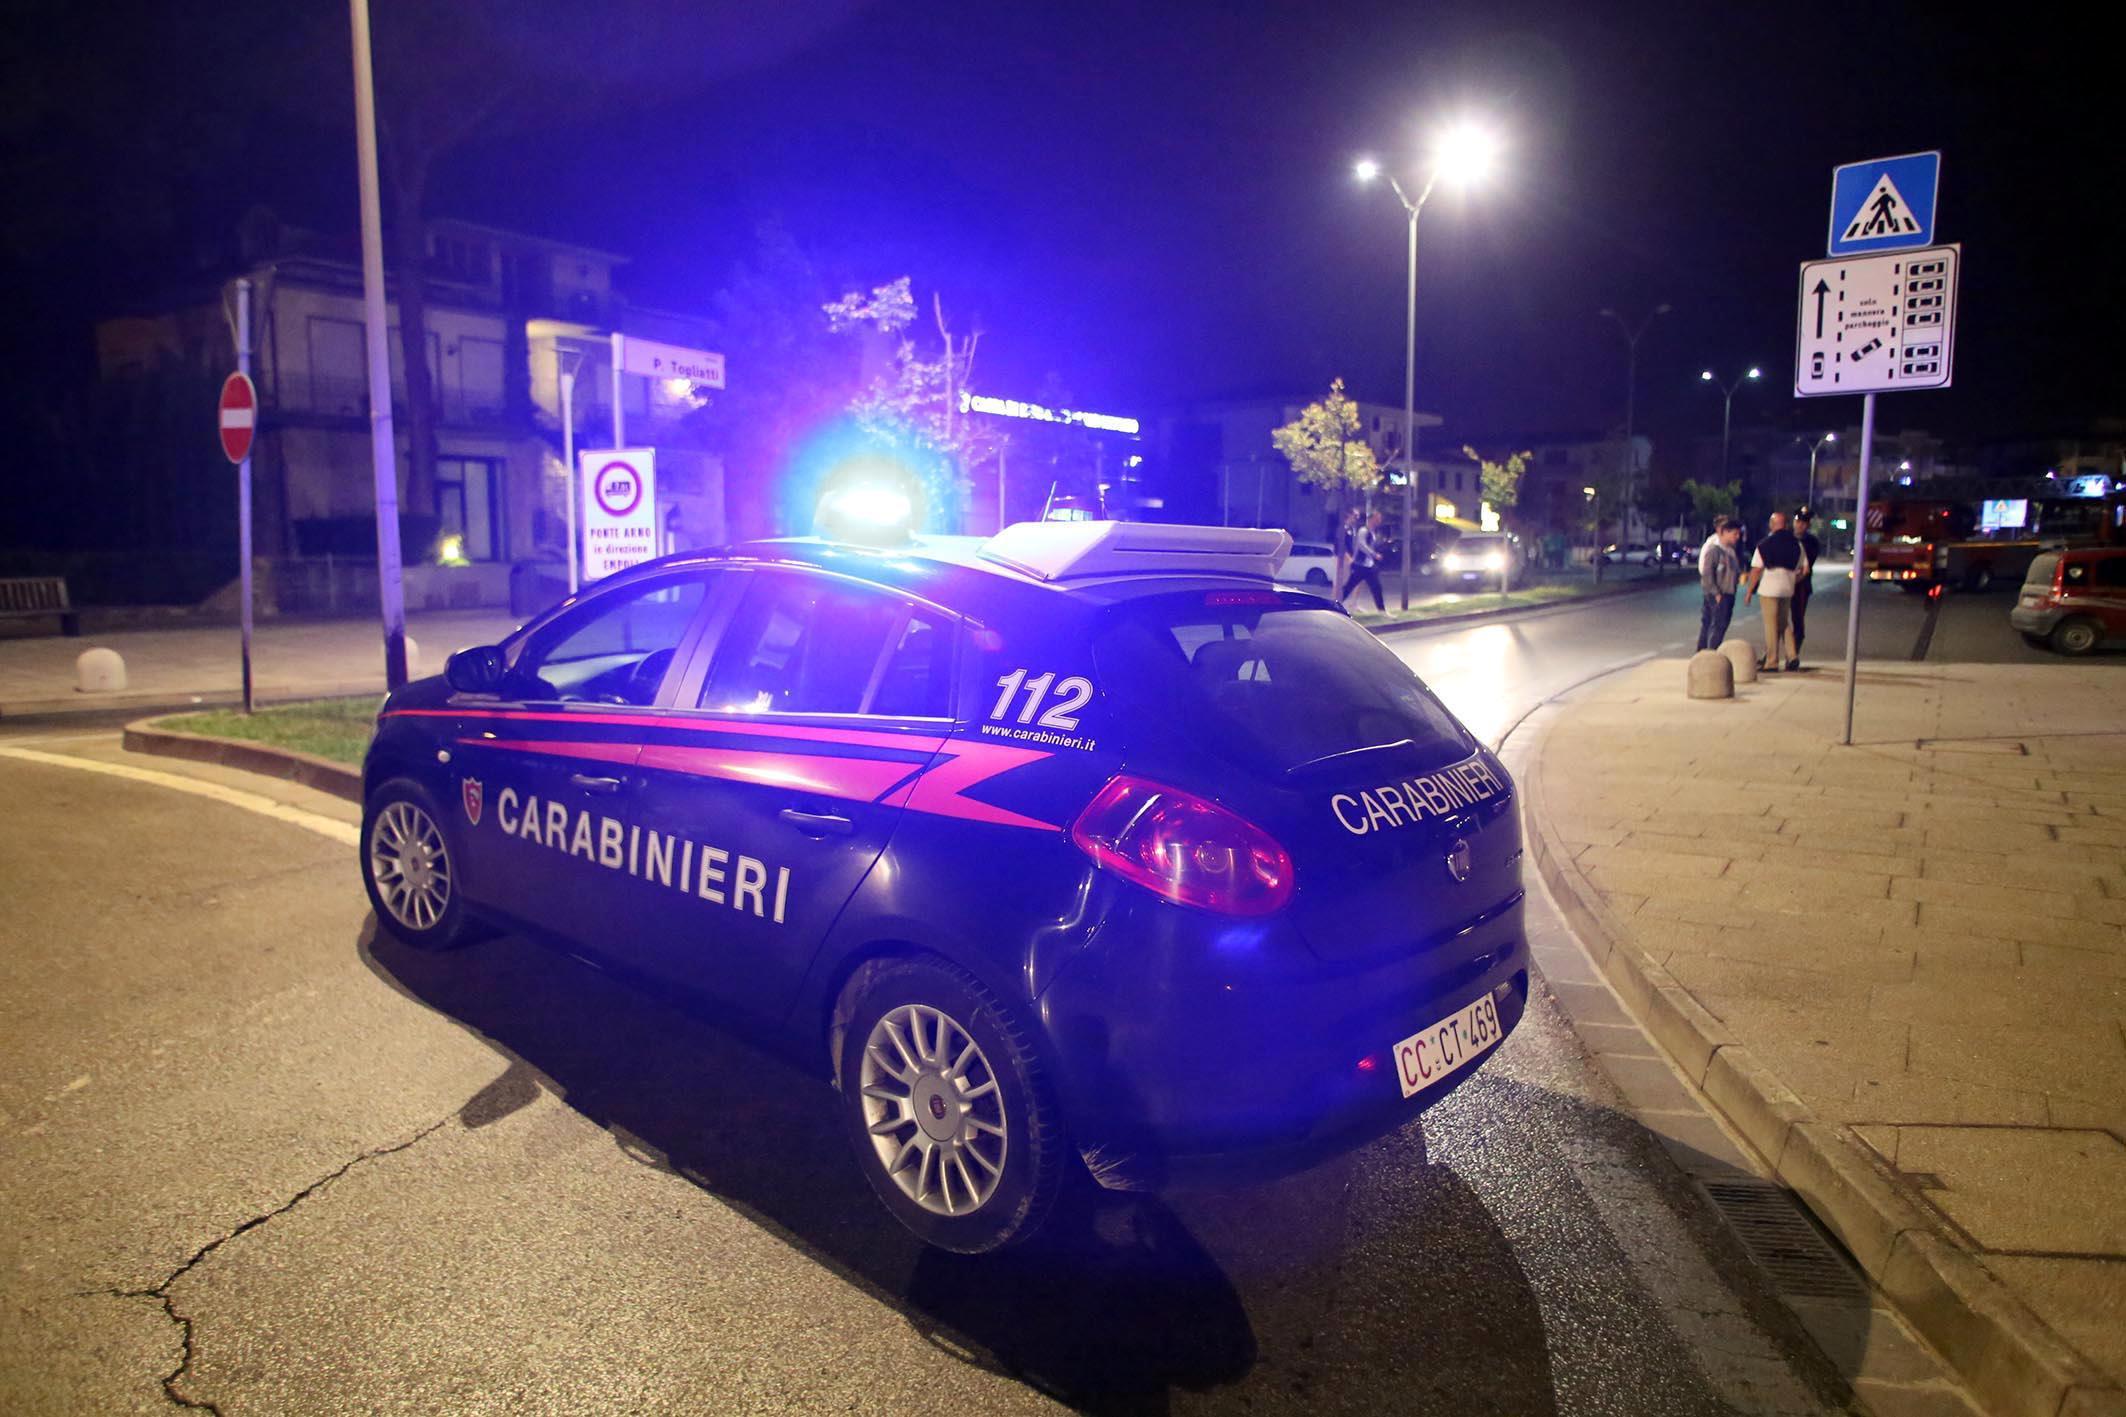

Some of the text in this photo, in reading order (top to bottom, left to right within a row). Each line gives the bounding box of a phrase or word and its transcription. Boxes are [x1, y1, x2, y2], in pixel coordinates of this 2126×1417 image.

[671, 360, 719, 380] Togliatti
[590, 527, 651, 538] PONTE ARNO
[606, 543, 648, 554] direzione
[990, 668, 1093, 731] 112
[981, 724, 1096, 751] www.carabinieri.it
[1330, 760, 1504, 835] CARABINIERI
[497, 786, 792, 924] CARABINIERI
[1400, 1039, 1431, 1087] CC
